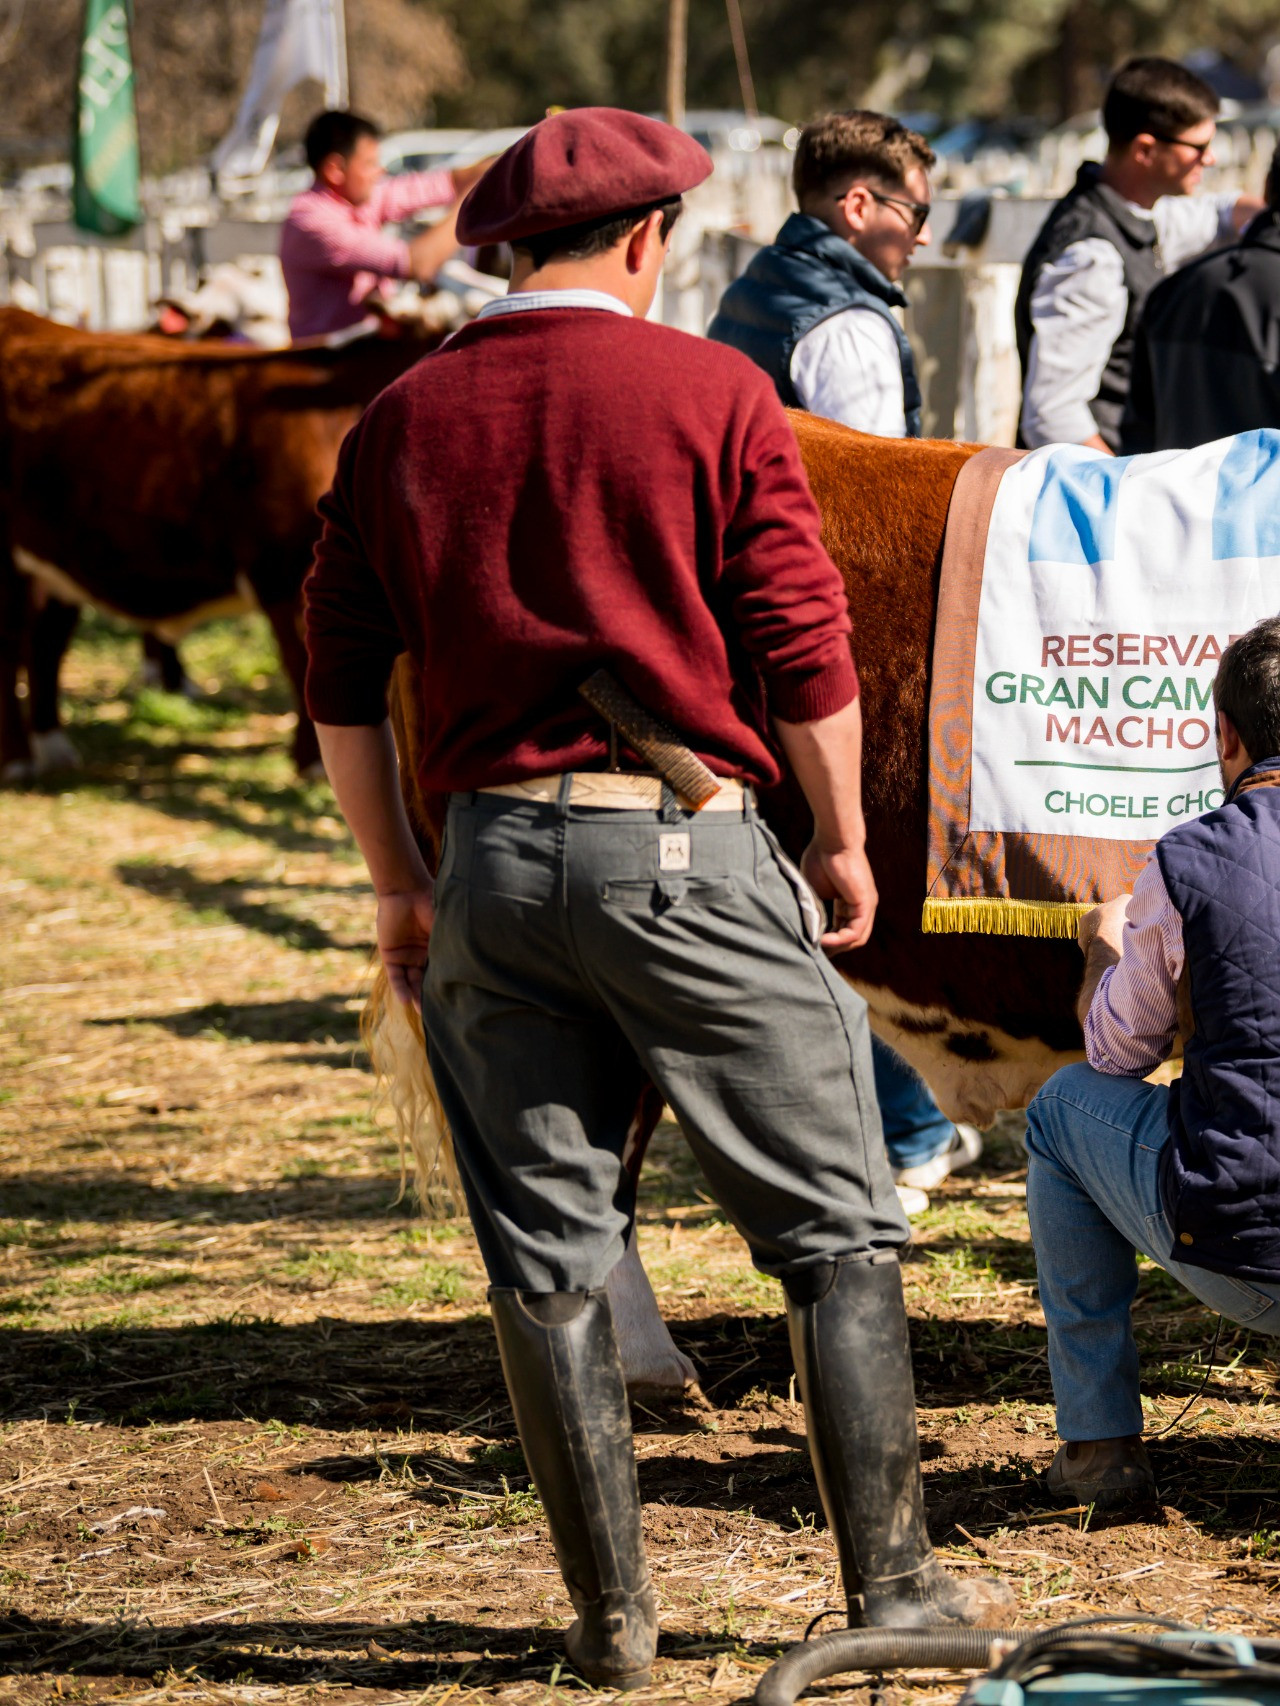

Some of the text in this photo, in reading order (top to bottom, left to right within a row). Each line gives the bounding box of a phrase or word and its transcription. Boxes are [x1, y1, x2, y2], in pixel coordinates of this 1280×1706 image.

[1041, 633, 1247, 668] RESERVA
[985, 671, 1109, 709] GRAN
[1045, 713, 1211, 750] MACHO
[1045, 788, 1226, 818] CHOELE CHO
